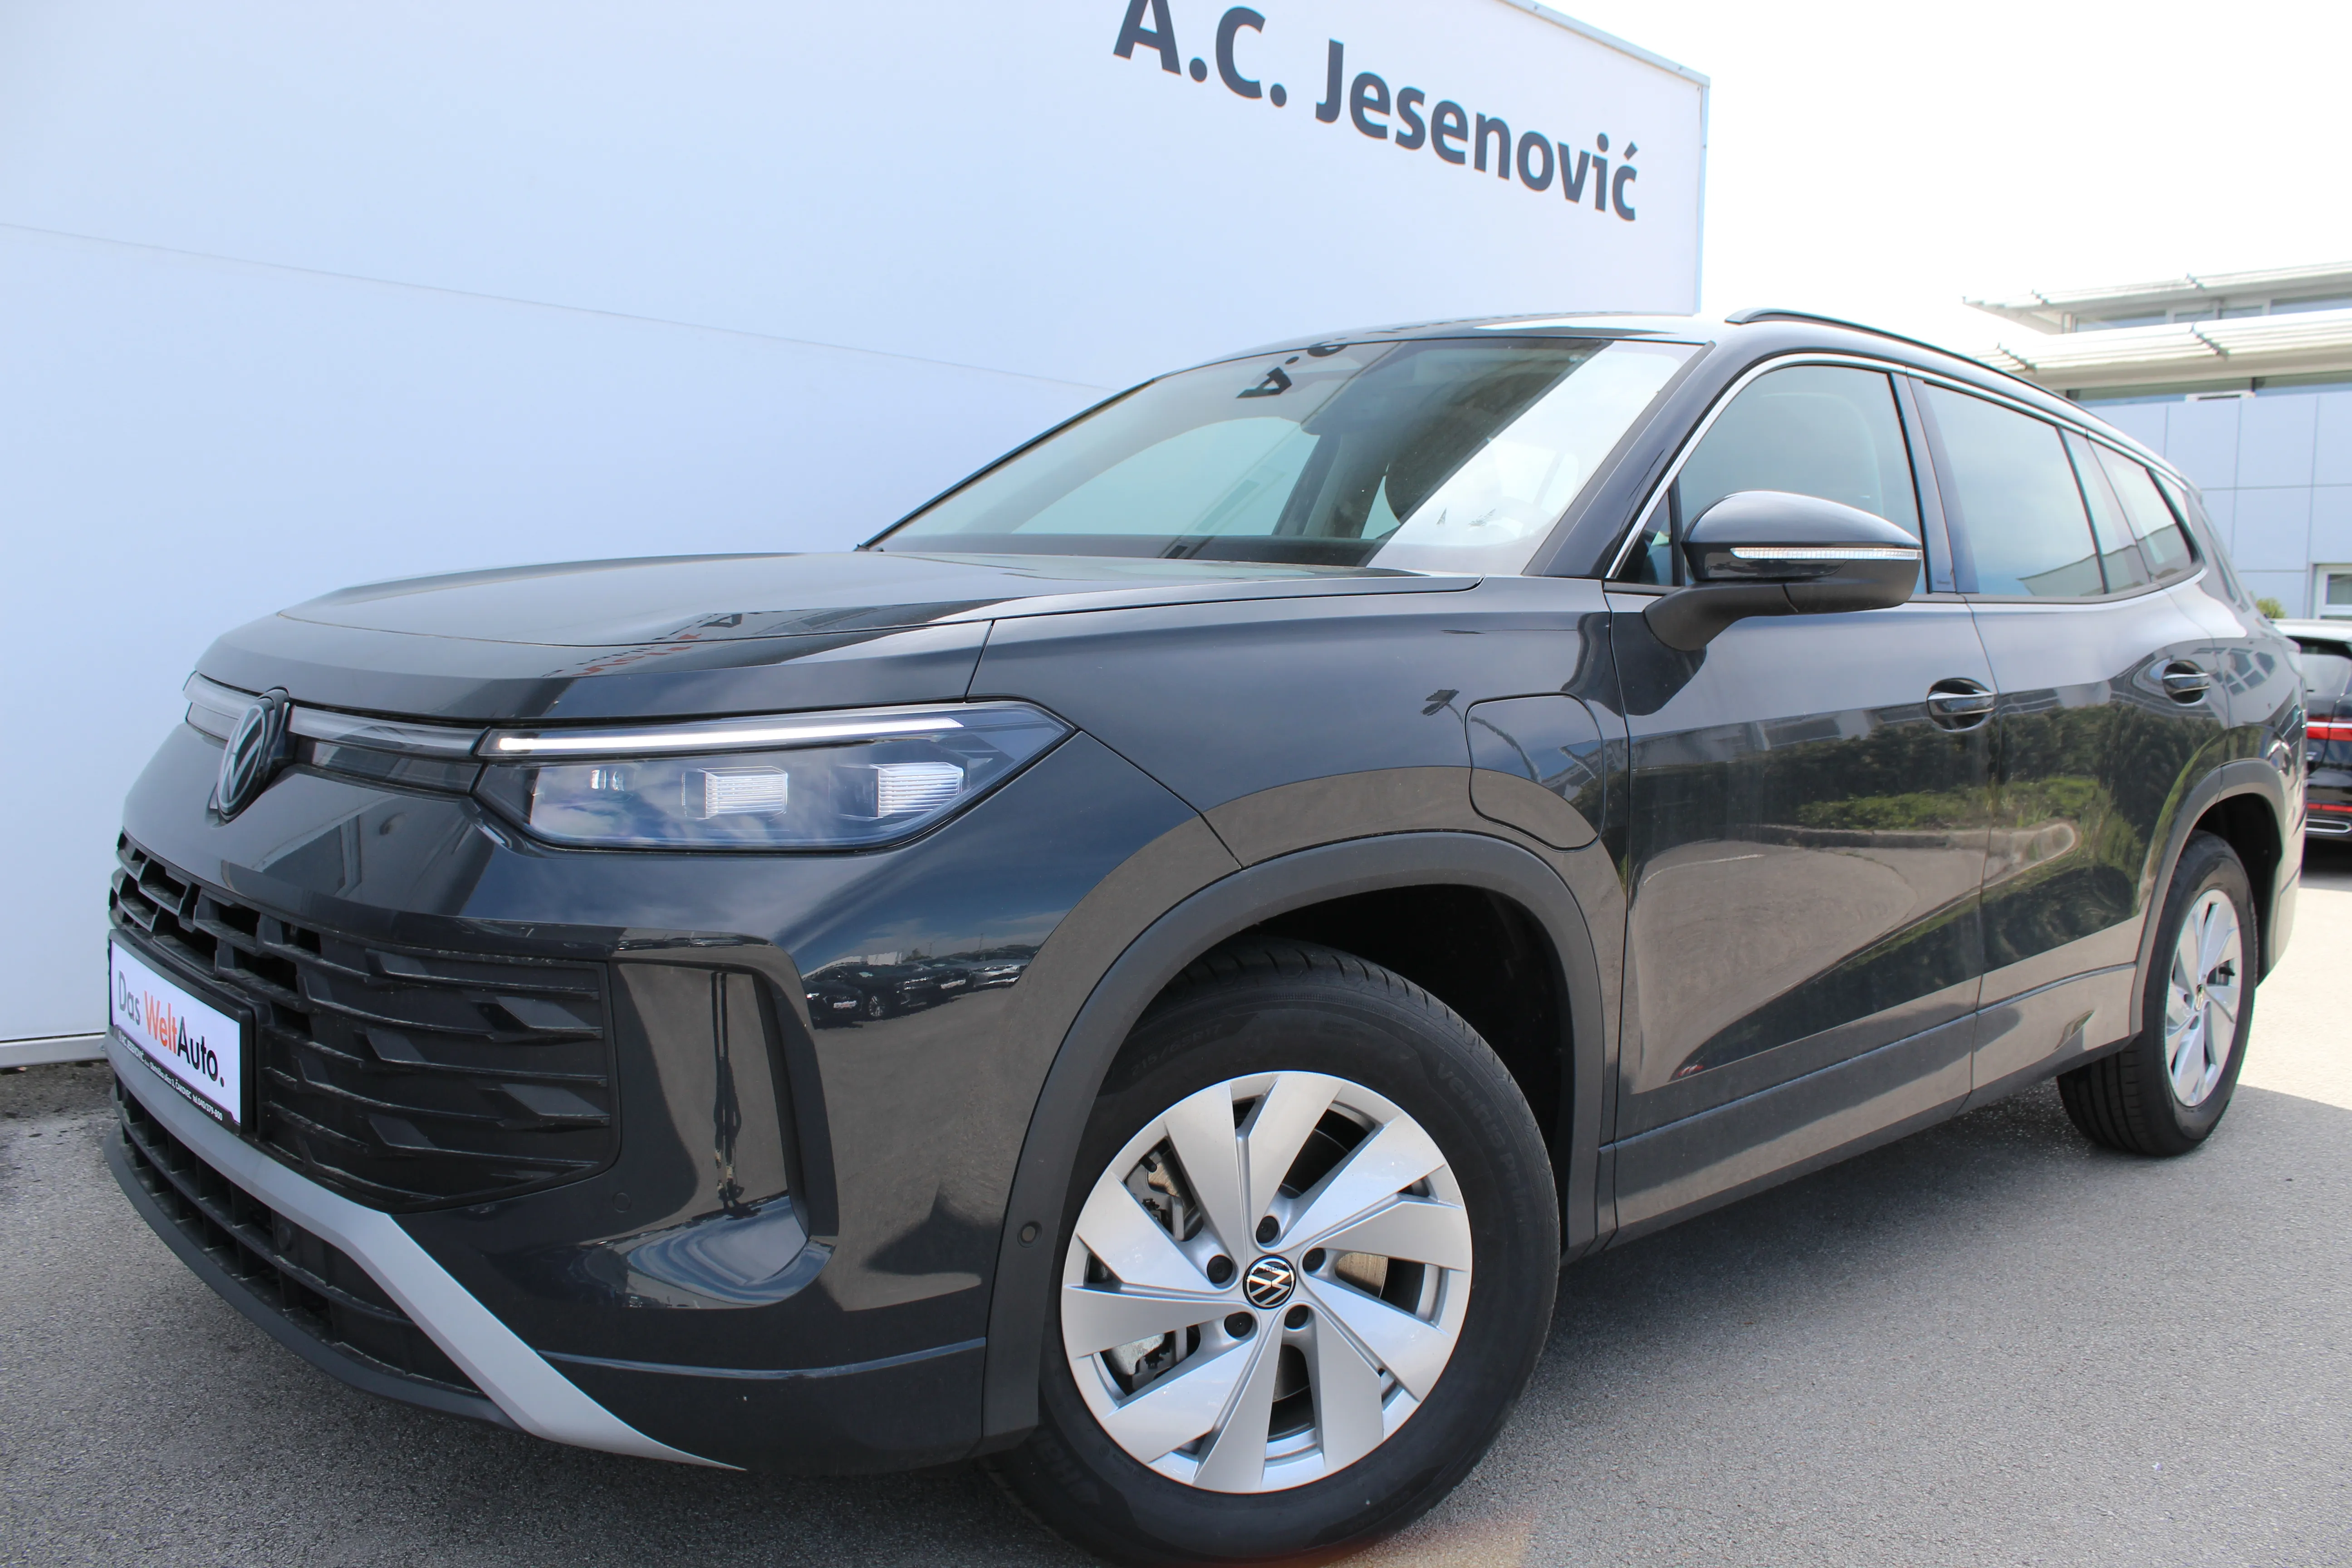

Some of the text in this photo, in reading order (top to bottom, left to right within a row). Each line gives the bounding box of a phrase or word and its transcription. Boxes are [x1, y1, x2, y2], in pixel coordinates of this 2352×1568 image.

[1112, 0, 1639, 222] A.C. Jesenović
[118, 970, 225, 1088] Das WeltAuto.
